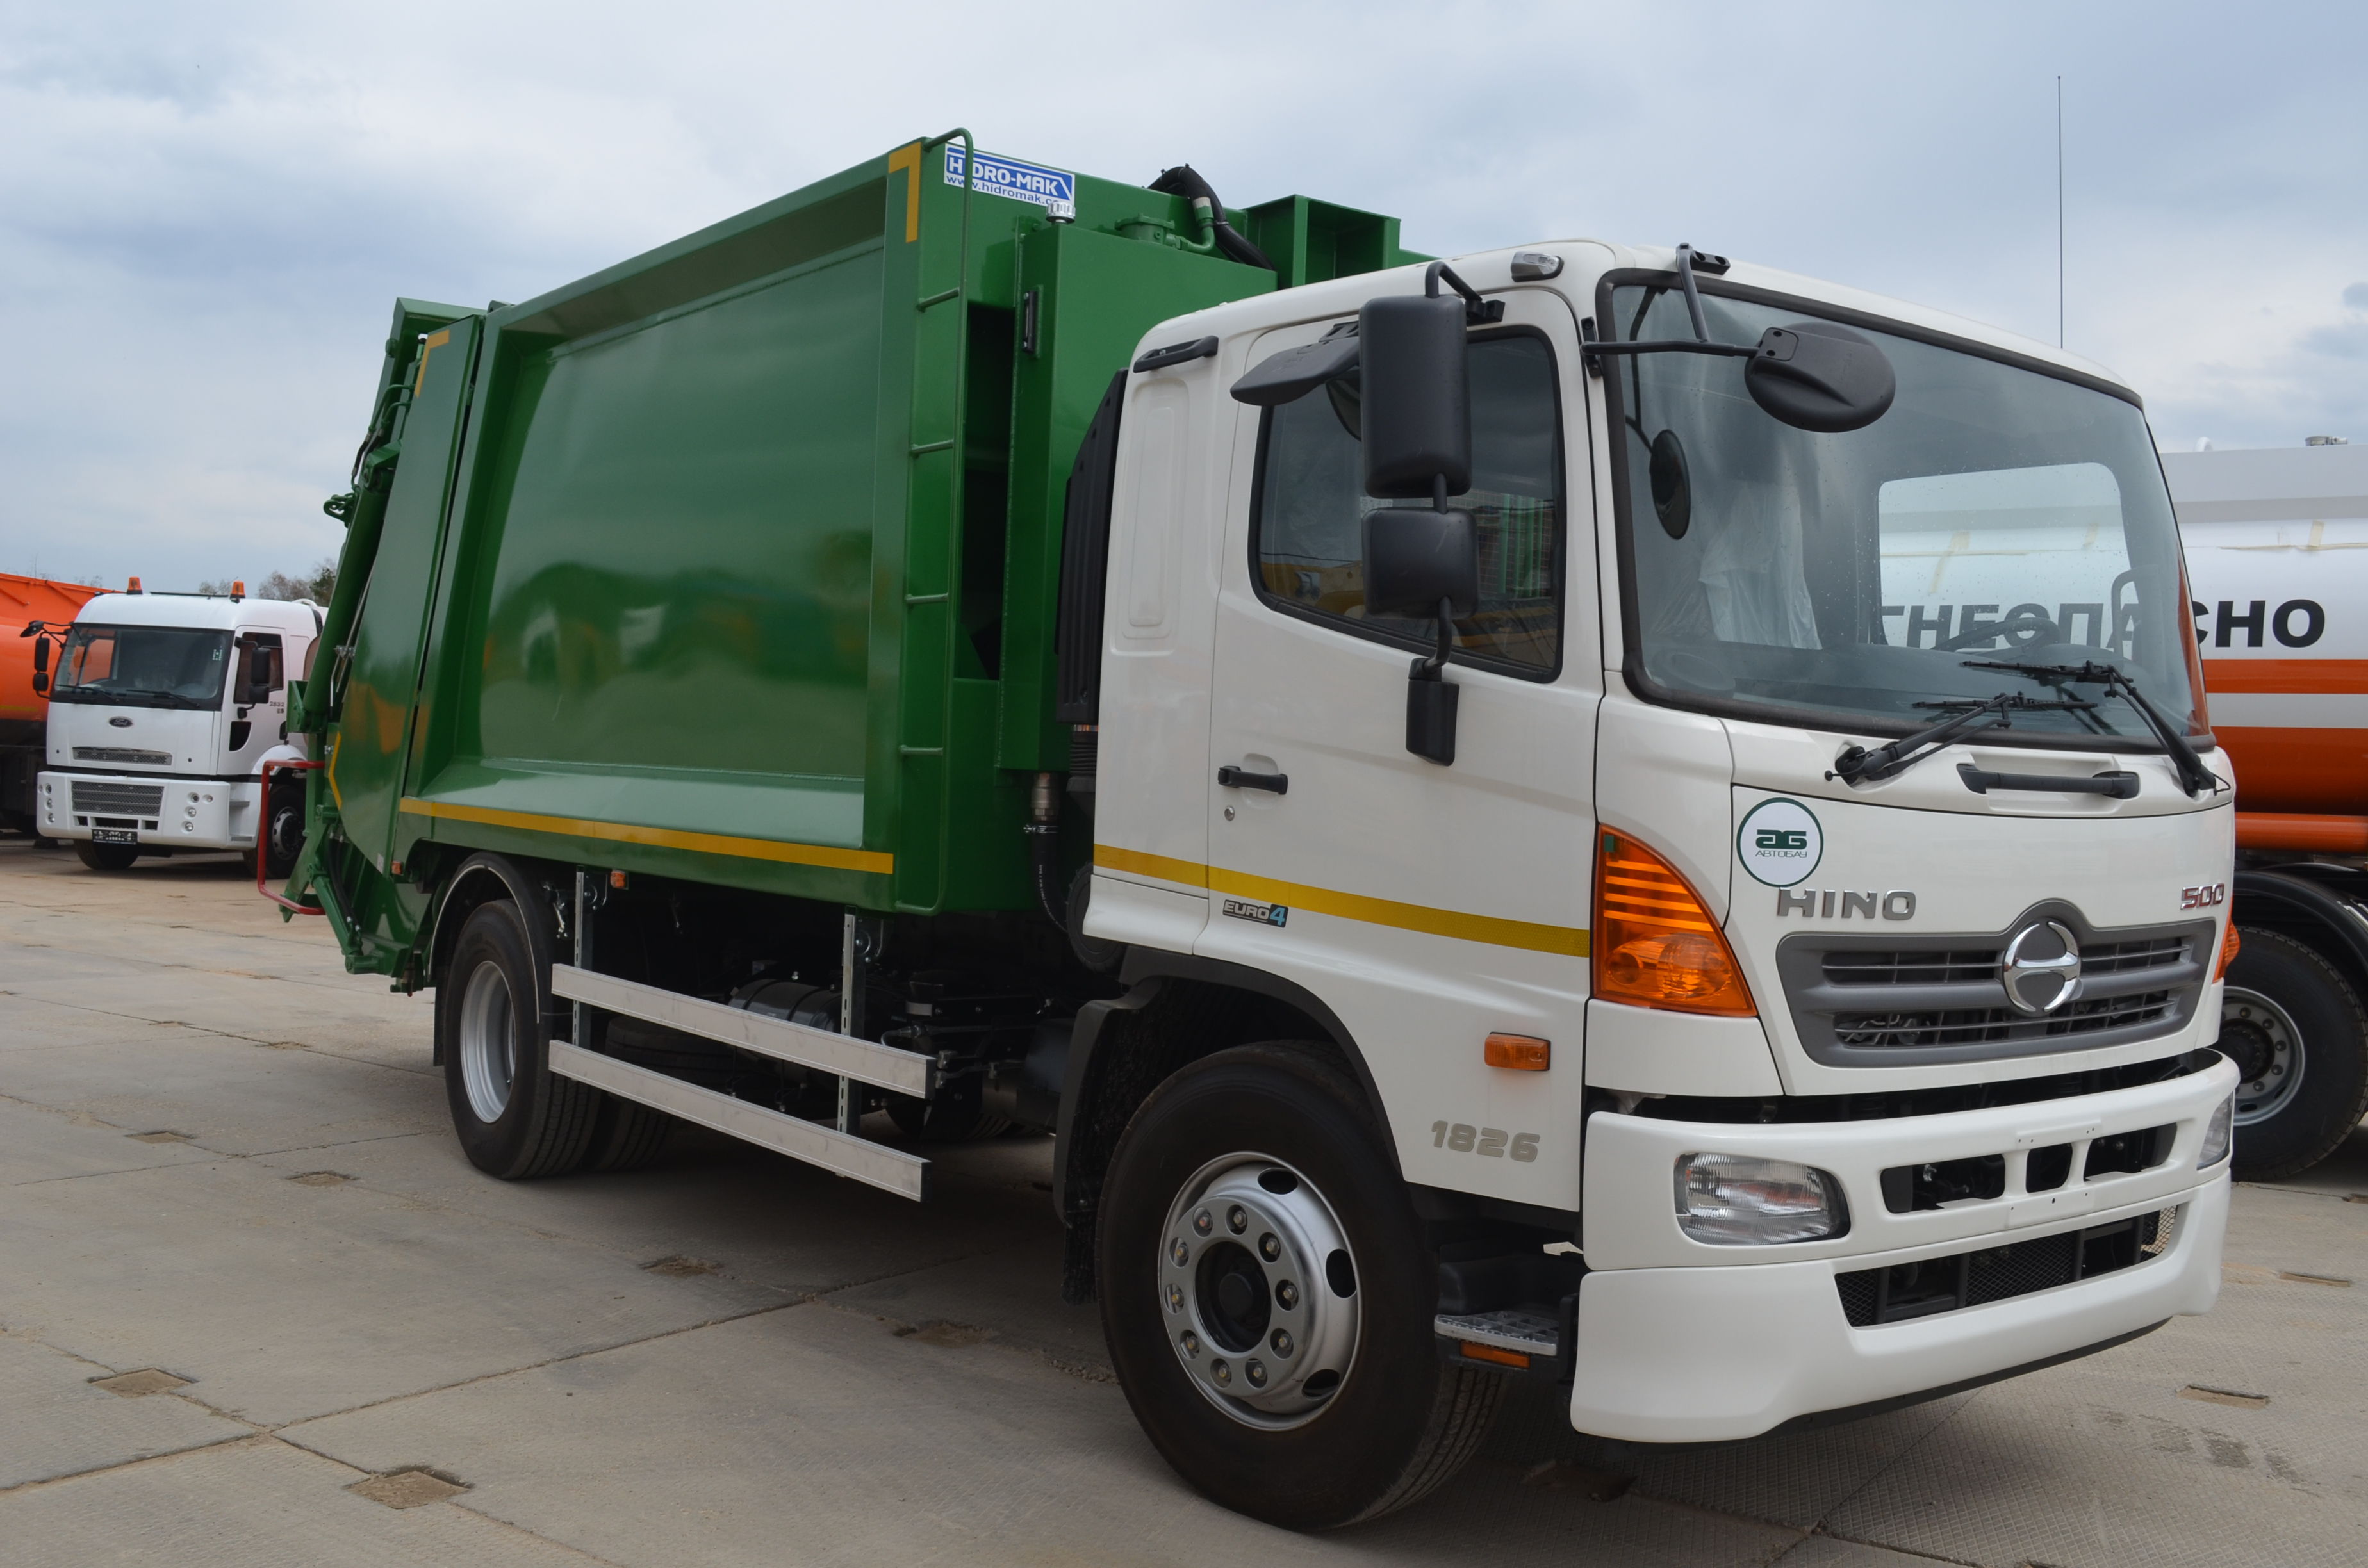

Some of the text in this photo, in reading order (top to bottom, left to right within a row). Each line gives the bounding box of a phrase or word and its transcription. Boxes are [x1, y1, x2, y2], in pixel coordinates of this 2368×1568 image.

[949, 156, 1058, 196] HDRO-MAK
[1755, 849, 1807, 858] АВТОБАУ
[1777, 887, 1916, 921] HINO
[2180, 883, 2224, 910] 500
[1431, 1120, 1540, 1163] 1826
